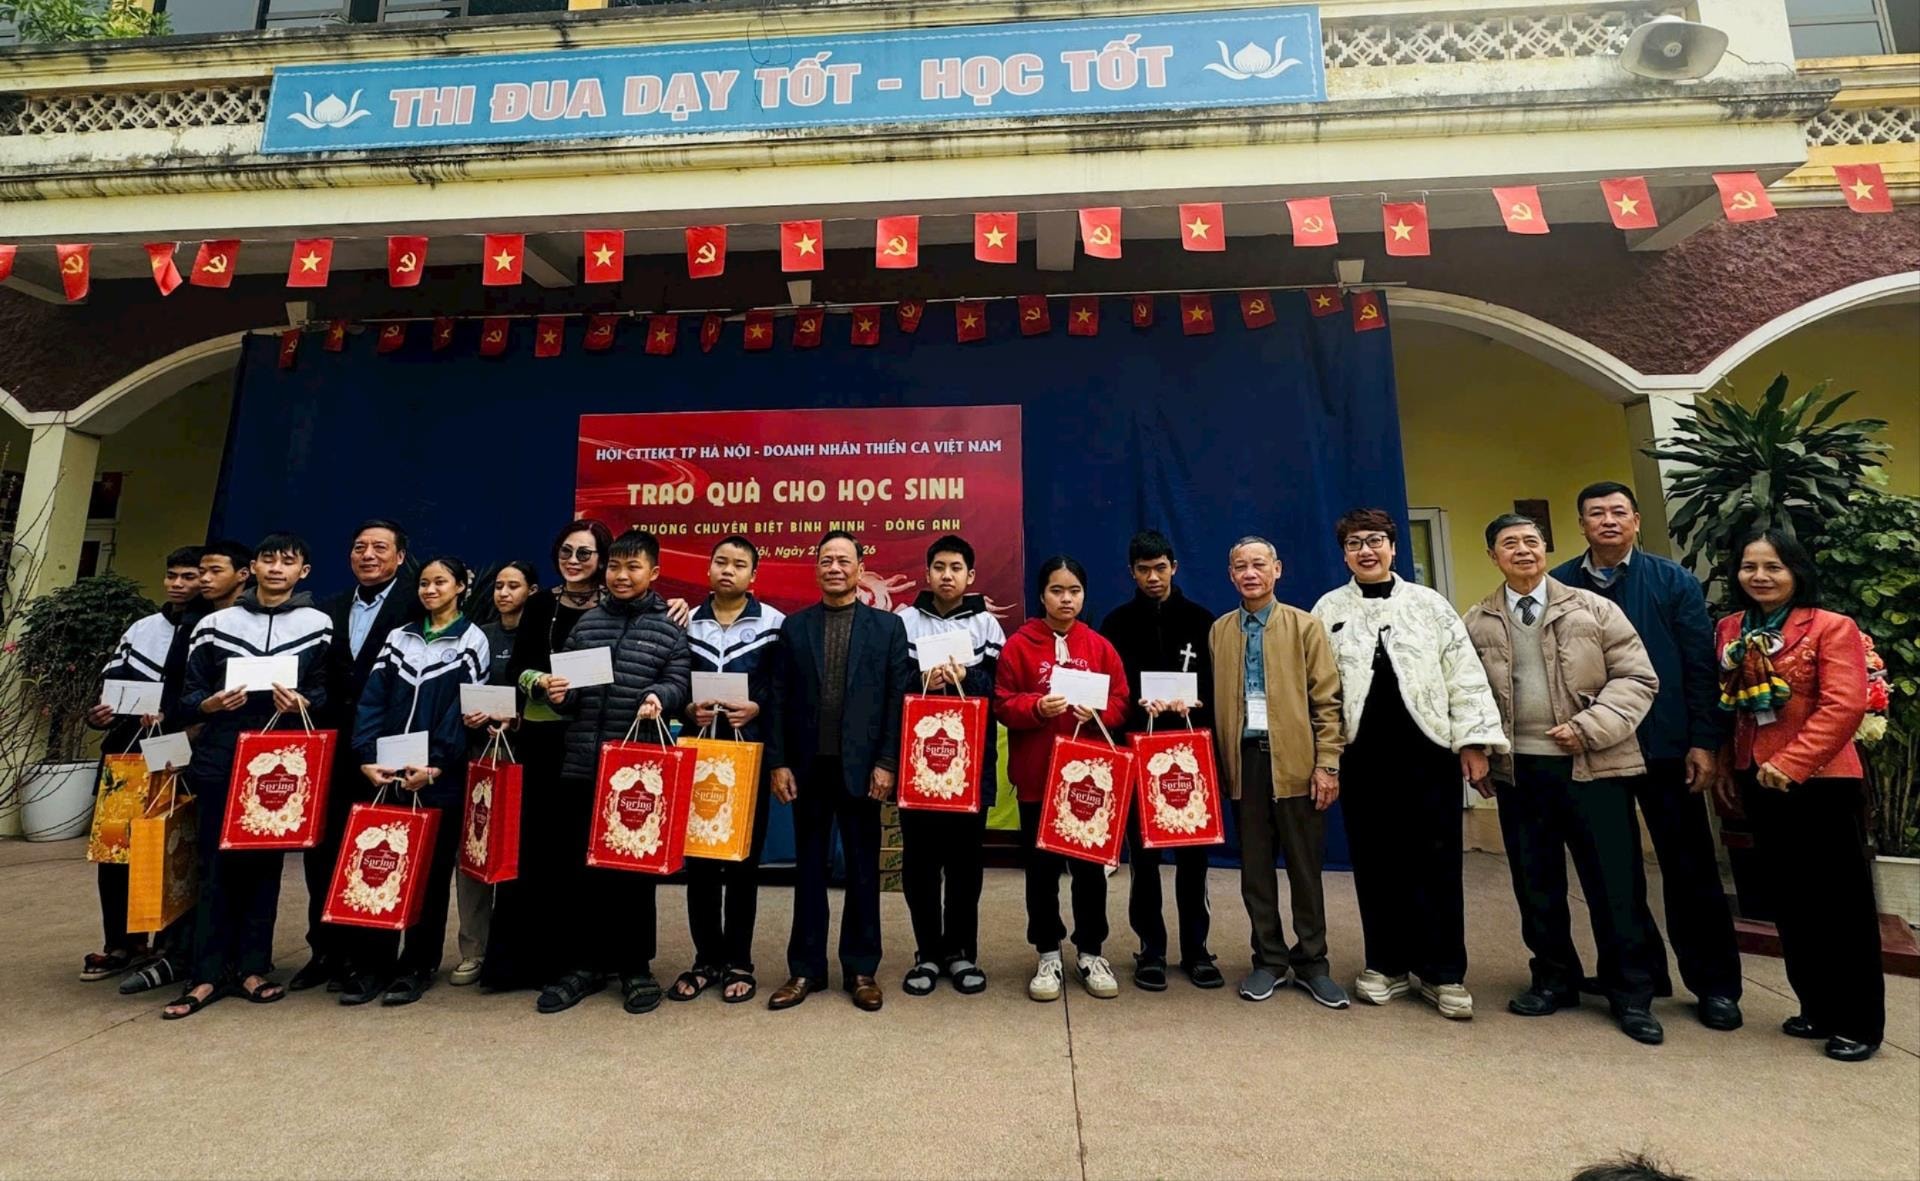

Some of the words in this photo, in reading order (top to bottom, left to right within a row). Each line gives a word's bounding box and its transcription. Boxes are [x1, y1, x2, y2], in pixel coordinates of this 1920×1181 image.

[390, 84, 477, 128] THI
[489, 78, 607, 124] ĐUA
[622, 70, 740, 122] DẠY
[754, 50, 862, 109] TỐT
[877, 77, 903, 91] -
[920, 53, 1045, 106] HỌC
[1060, 33, 1174, 92] TỐT
[596, 445, 622, 462] HỘI
[626, 447, 676, 460] CTTEKT
[680, 446, 697, 459] TP
[700, 444, 720, 458] HÀ
[723, 443, 751, 461] NỘI
[763, 443, 815, 457] DOANH
[819, 441, 861, 456] NHÂN
[911, 441, 930, 454] CA
[934, 438, 965, 456] VIỆT
[968, 440, 1002, 453] NAM
[627, 482, 695, 506] TRAO
[707, 477, 761, 507] QUÀ
[773, 479, 826, 503] CHO
[838, 478, 893, 506] HỌC
[904, 477, 965, 501] SINH
[694, 520, 748, 534] CHUYÊN
[755, 520, 784, 535] BIỆT
[829, 520, 865, 532] MINH
[885, 518, 925, 531] ĐÔNG
[932, 519, 961, 531] ANH
[756, 547, 772, 559] ội,
[774, 545, 804, 559] Ngày
[259, 781, 295, 793] Spring
[1162, 779, 1193, 791] Spring
[620, 798, 652, 811] Spring
[1070, 787, 1101, 806] Spring
